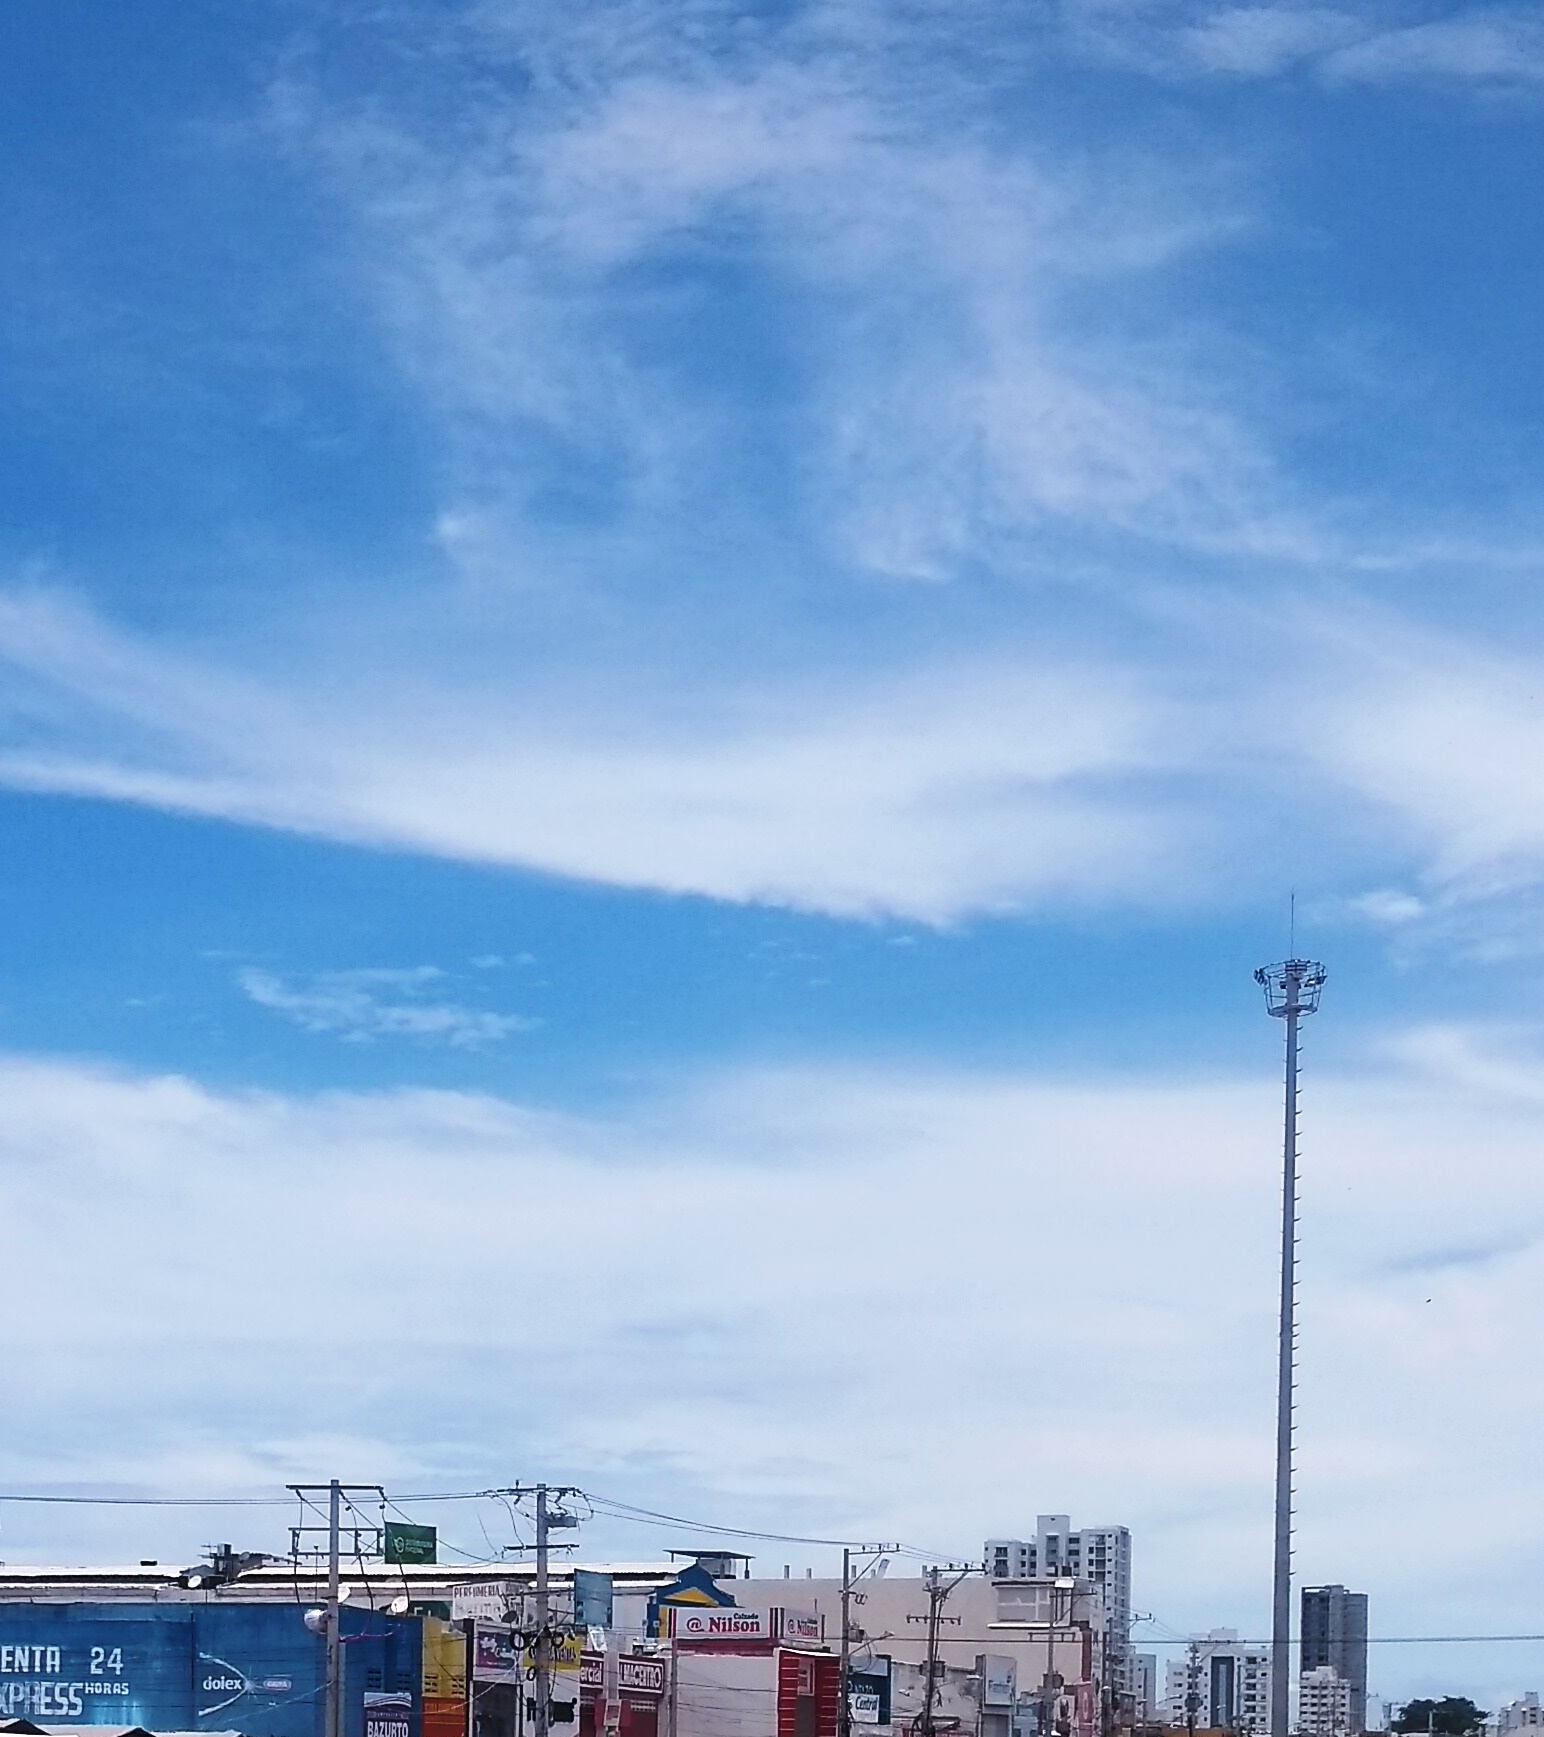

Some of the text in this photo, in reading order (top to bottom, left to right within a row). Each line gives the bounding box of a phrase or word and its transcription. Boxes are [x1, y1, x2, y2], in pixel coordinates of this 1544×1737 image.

[709, 1617, 760, 1632] Nilson
[90, 1647, 123, 1675] 24
[85, 1683, 129, 1695] HORAS
[203, 1676, 242, 1690] dolex
